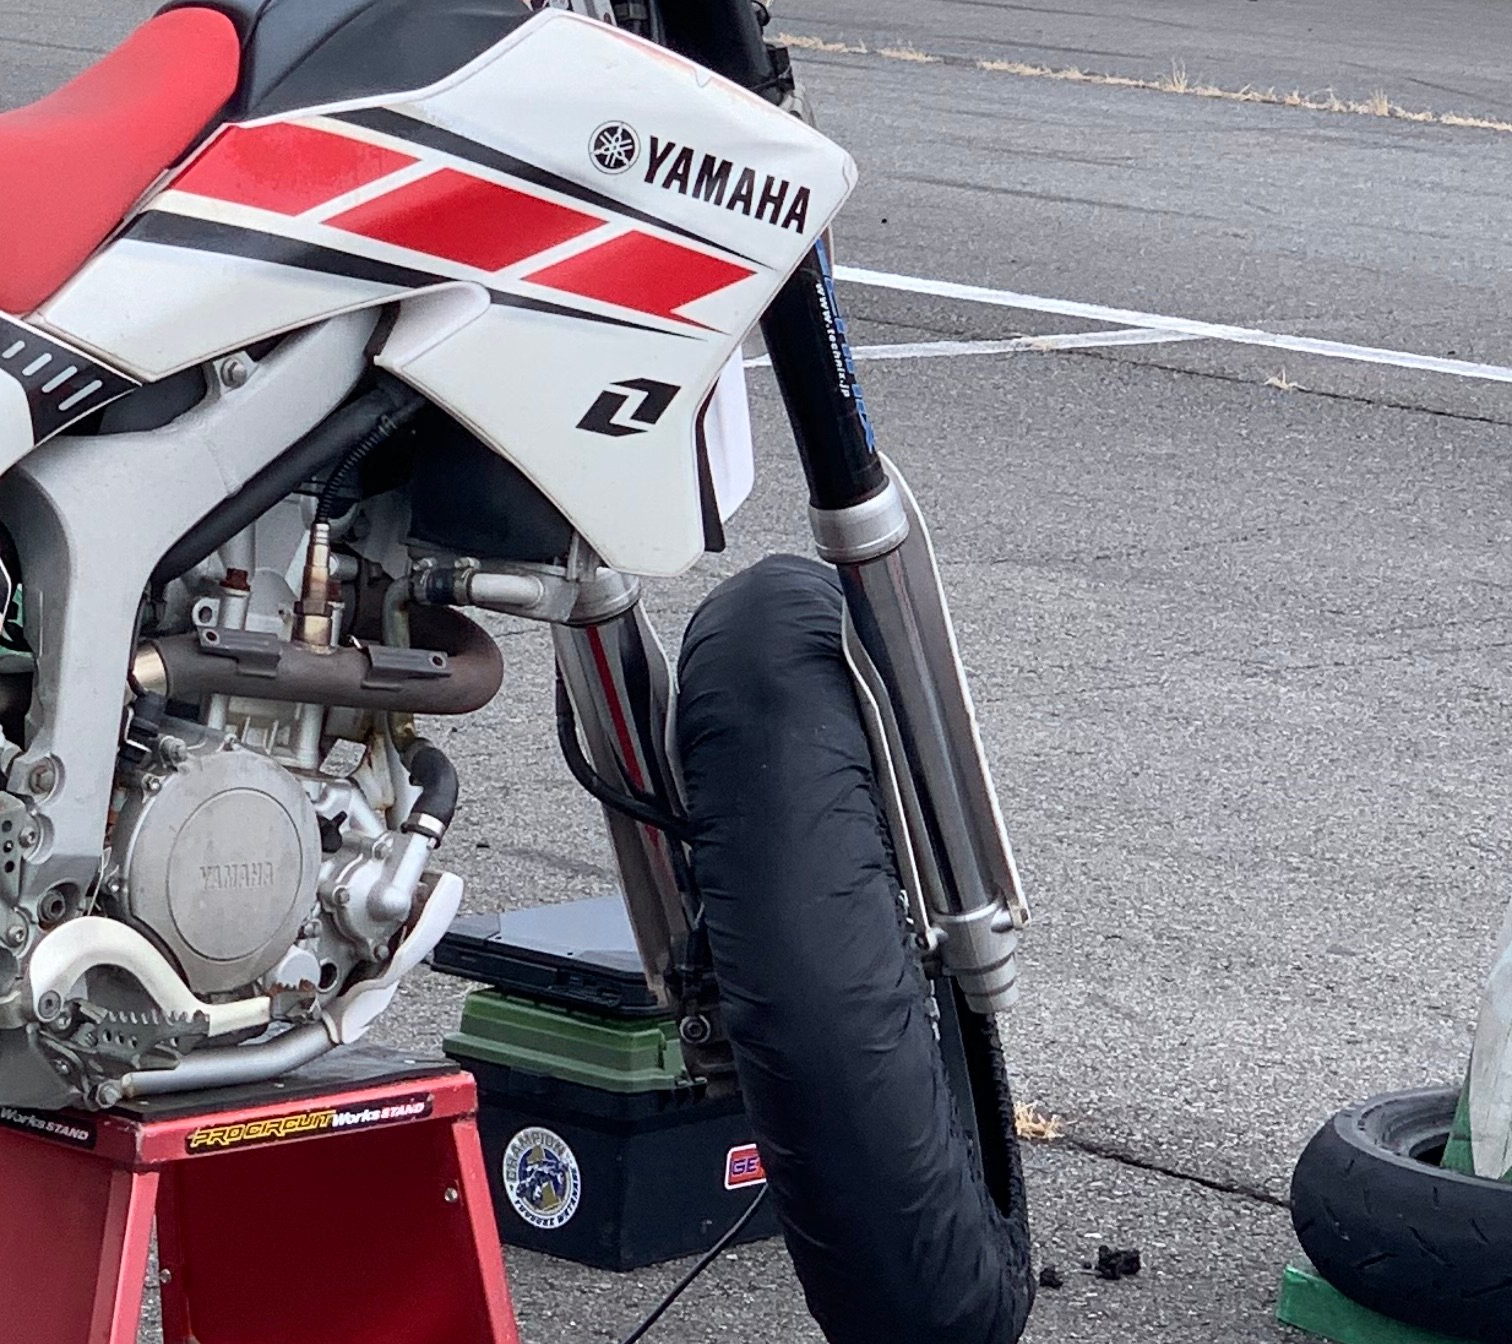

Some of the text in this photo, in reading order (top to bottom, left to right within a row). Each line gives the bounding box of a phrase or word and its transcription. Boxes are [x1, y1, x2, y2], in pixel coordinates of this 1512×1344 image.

[644, 135, 811, 235] YAMAHA
[815, 281, 851, 398] www.technix.jp
[199, 860, 275, 890] YAMAHA
[190, 1123, 244, 1149] PRO
[242, 1109, 336, 1139] CIRCUIT
